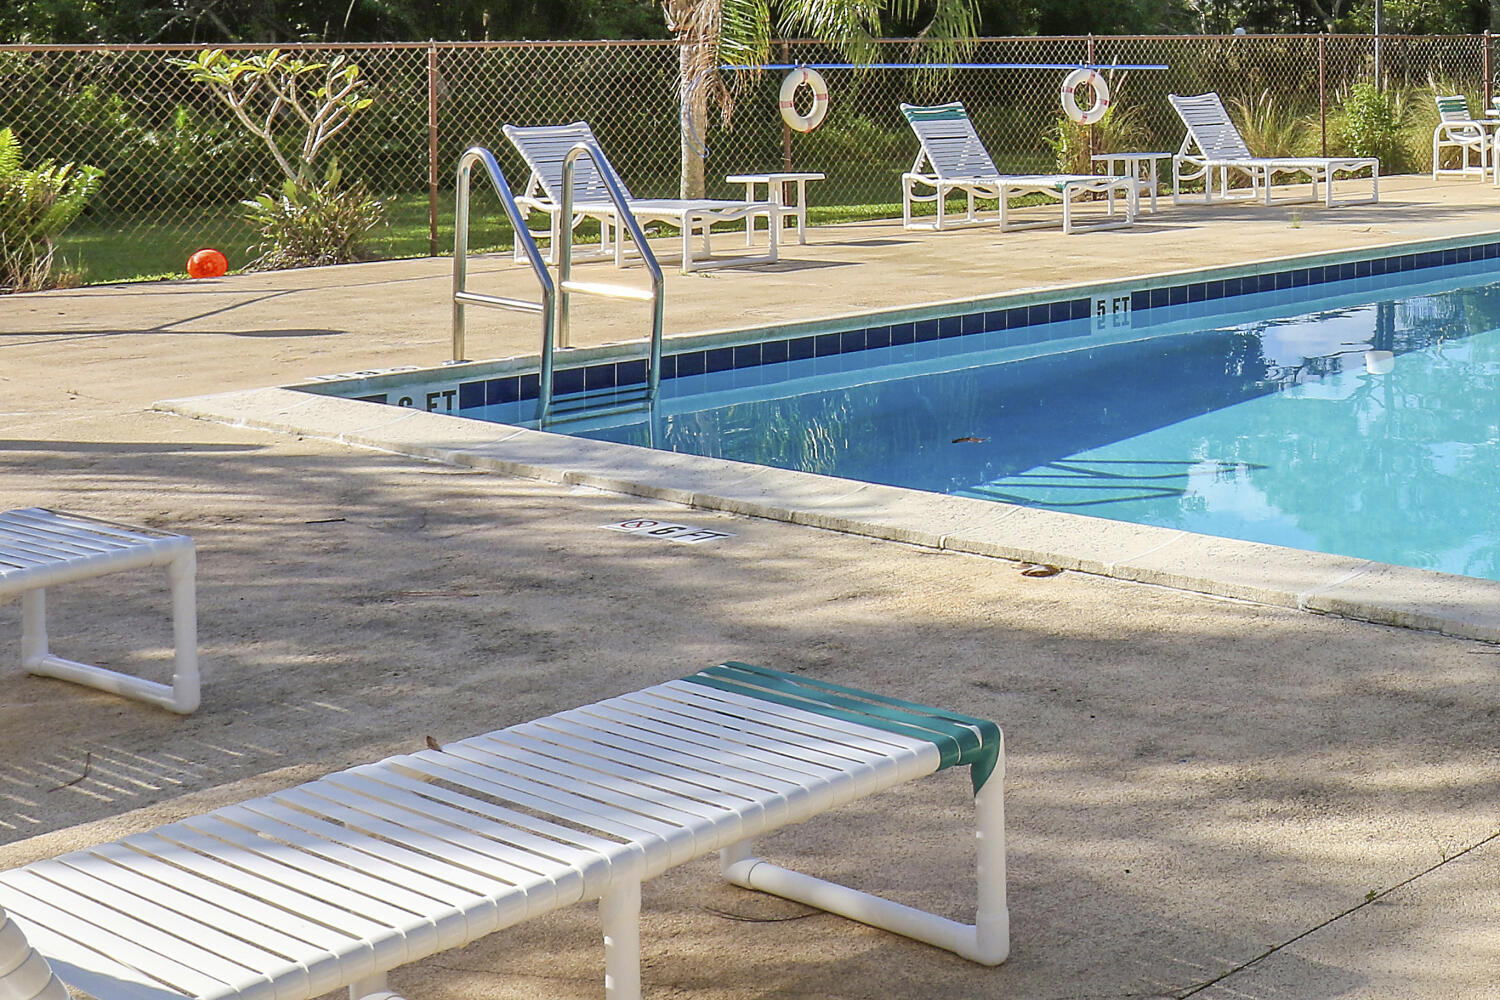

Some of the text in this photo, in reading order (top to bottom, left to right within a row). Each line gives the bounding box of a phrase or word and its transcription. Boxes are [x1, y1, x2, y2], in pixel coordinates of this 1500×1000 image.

[1096, 296, 1130, 316] 5 FT
[426, 389, 457, 412] FT
[648, 526, 729, 542] 6 FT
